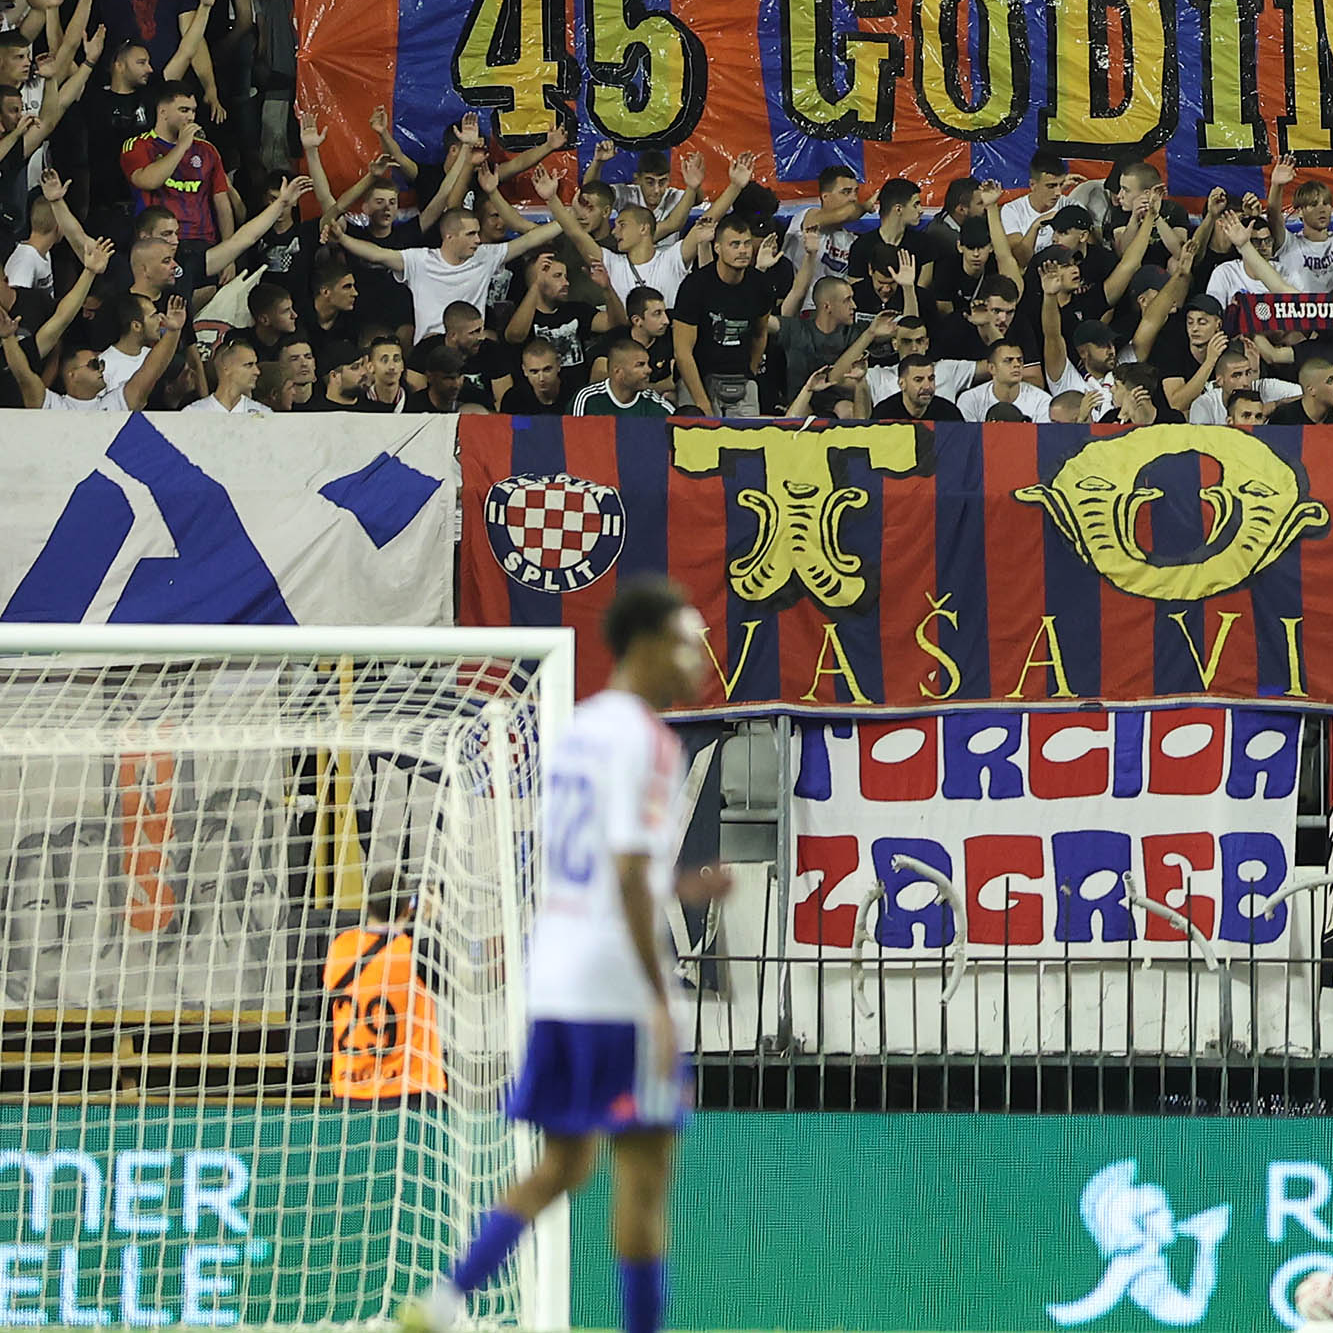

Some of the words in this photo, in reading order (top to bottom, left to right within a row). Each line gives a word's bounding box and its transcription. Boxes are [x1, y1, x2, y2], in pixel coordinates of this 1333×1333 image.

[501, 549, 597, 586] SPLIT
[701, 592, 1080, 706] VAŠA
[793, 709, 1302, 802] TORCIDA
[793, 829, 1289, 949] ZAGREB
